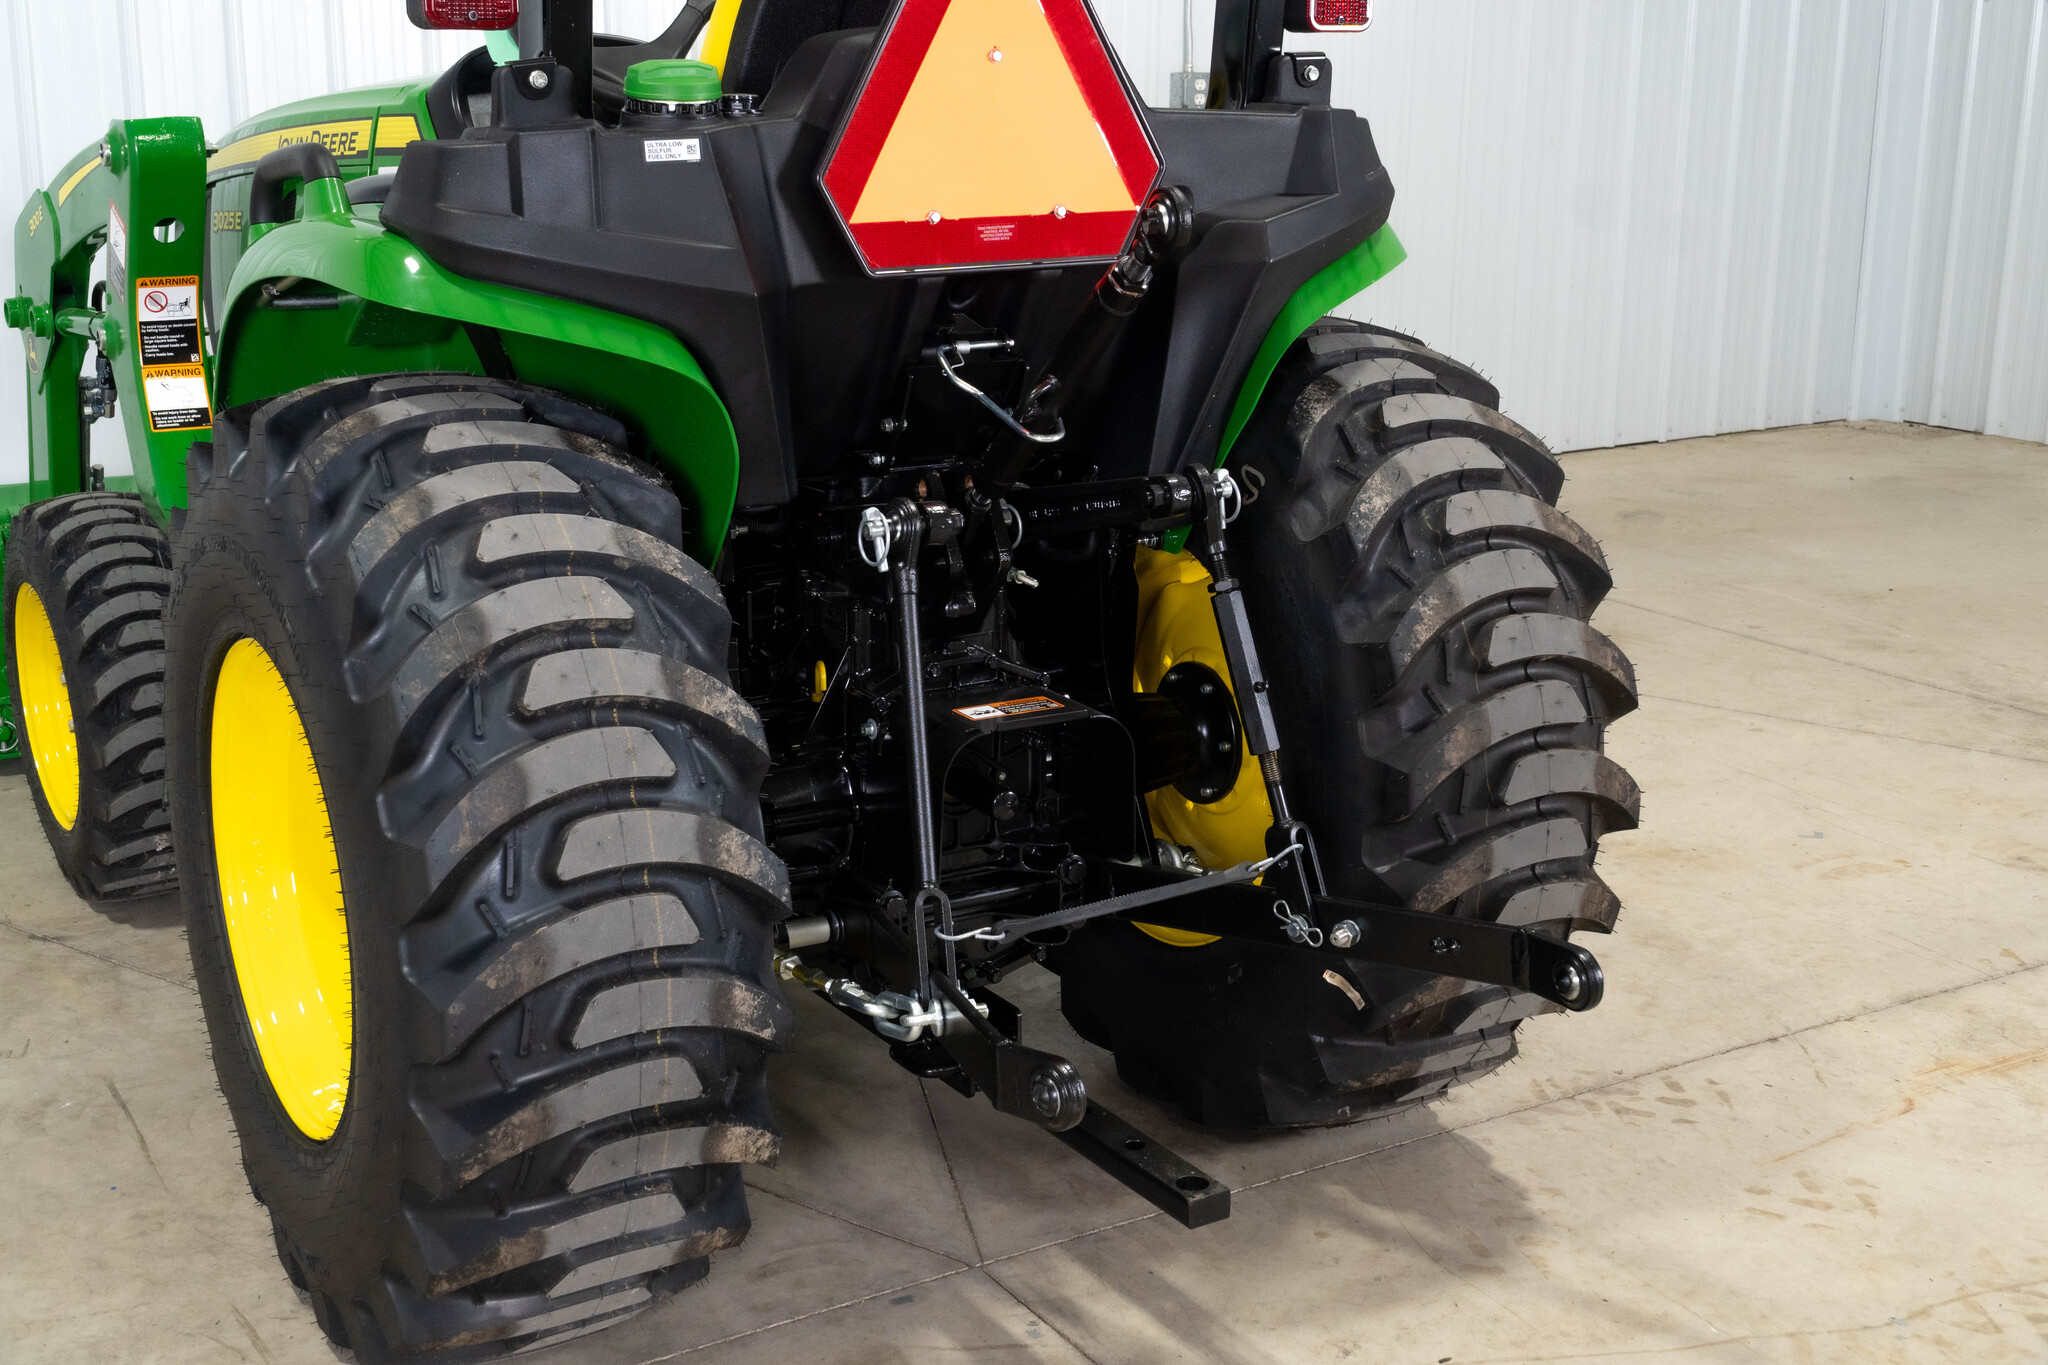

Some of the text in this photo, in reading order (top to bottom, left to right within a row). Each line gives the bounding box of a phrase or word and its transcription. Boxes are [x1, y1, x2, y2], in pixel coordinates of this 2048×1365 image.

[310, 130, 359, 153] DEERE
[213, 211, 243, 232] 3025E
[149, 277, 196, 286] WARNING
[154, 368, 201, 377] WARNING
